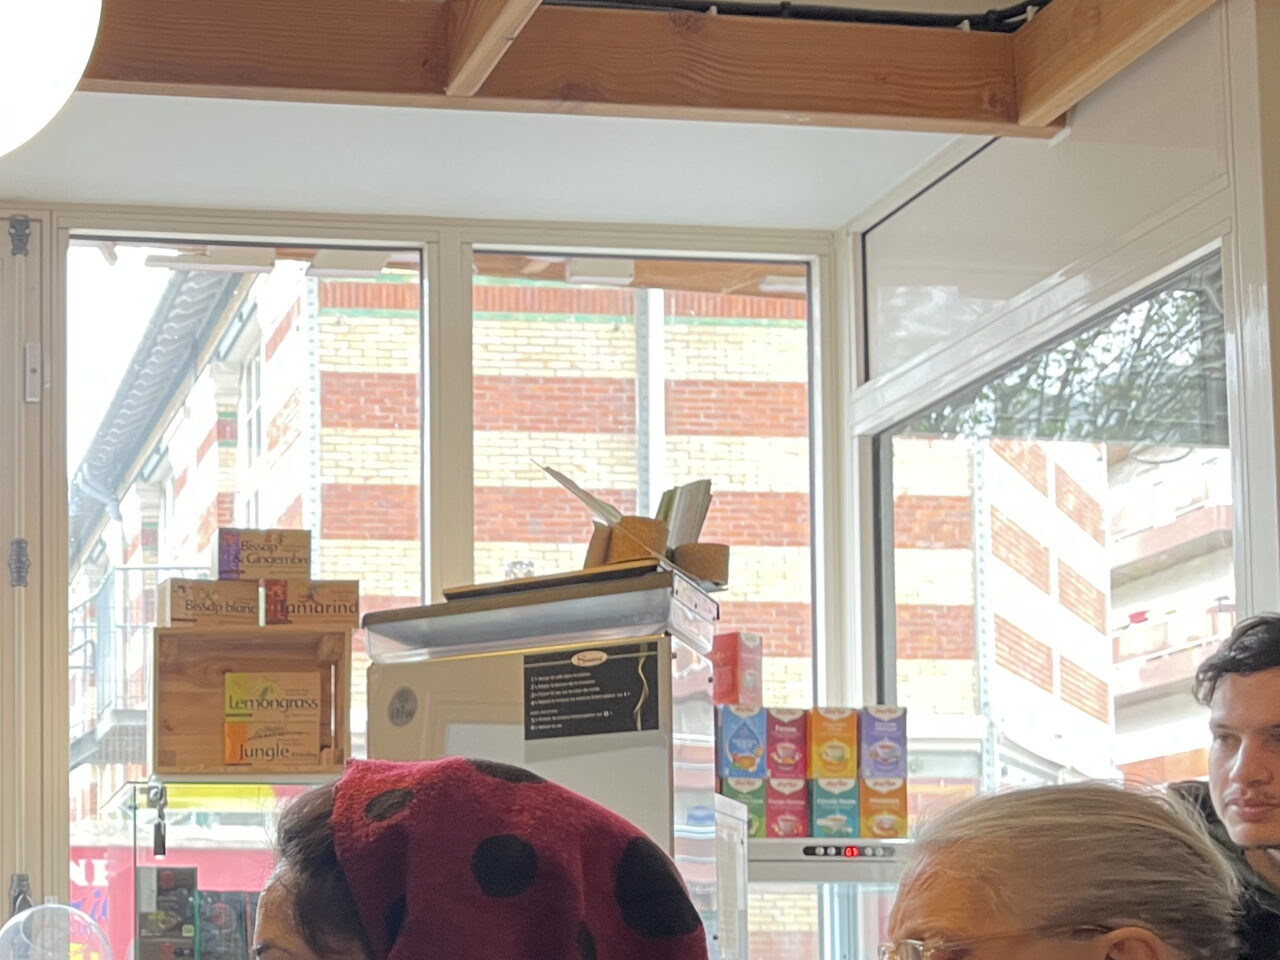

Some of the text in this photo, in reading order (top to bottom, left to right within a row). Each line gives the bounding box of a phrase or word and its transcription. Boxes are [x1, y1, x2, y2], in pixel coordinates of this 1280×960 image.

[241, 539, 278, 554] Bissap
[185, 599, 257, 615] Bissap blanc
[229, 695, 319, 713] Lemongrass
[240, 742, 290, 762] Jungle
